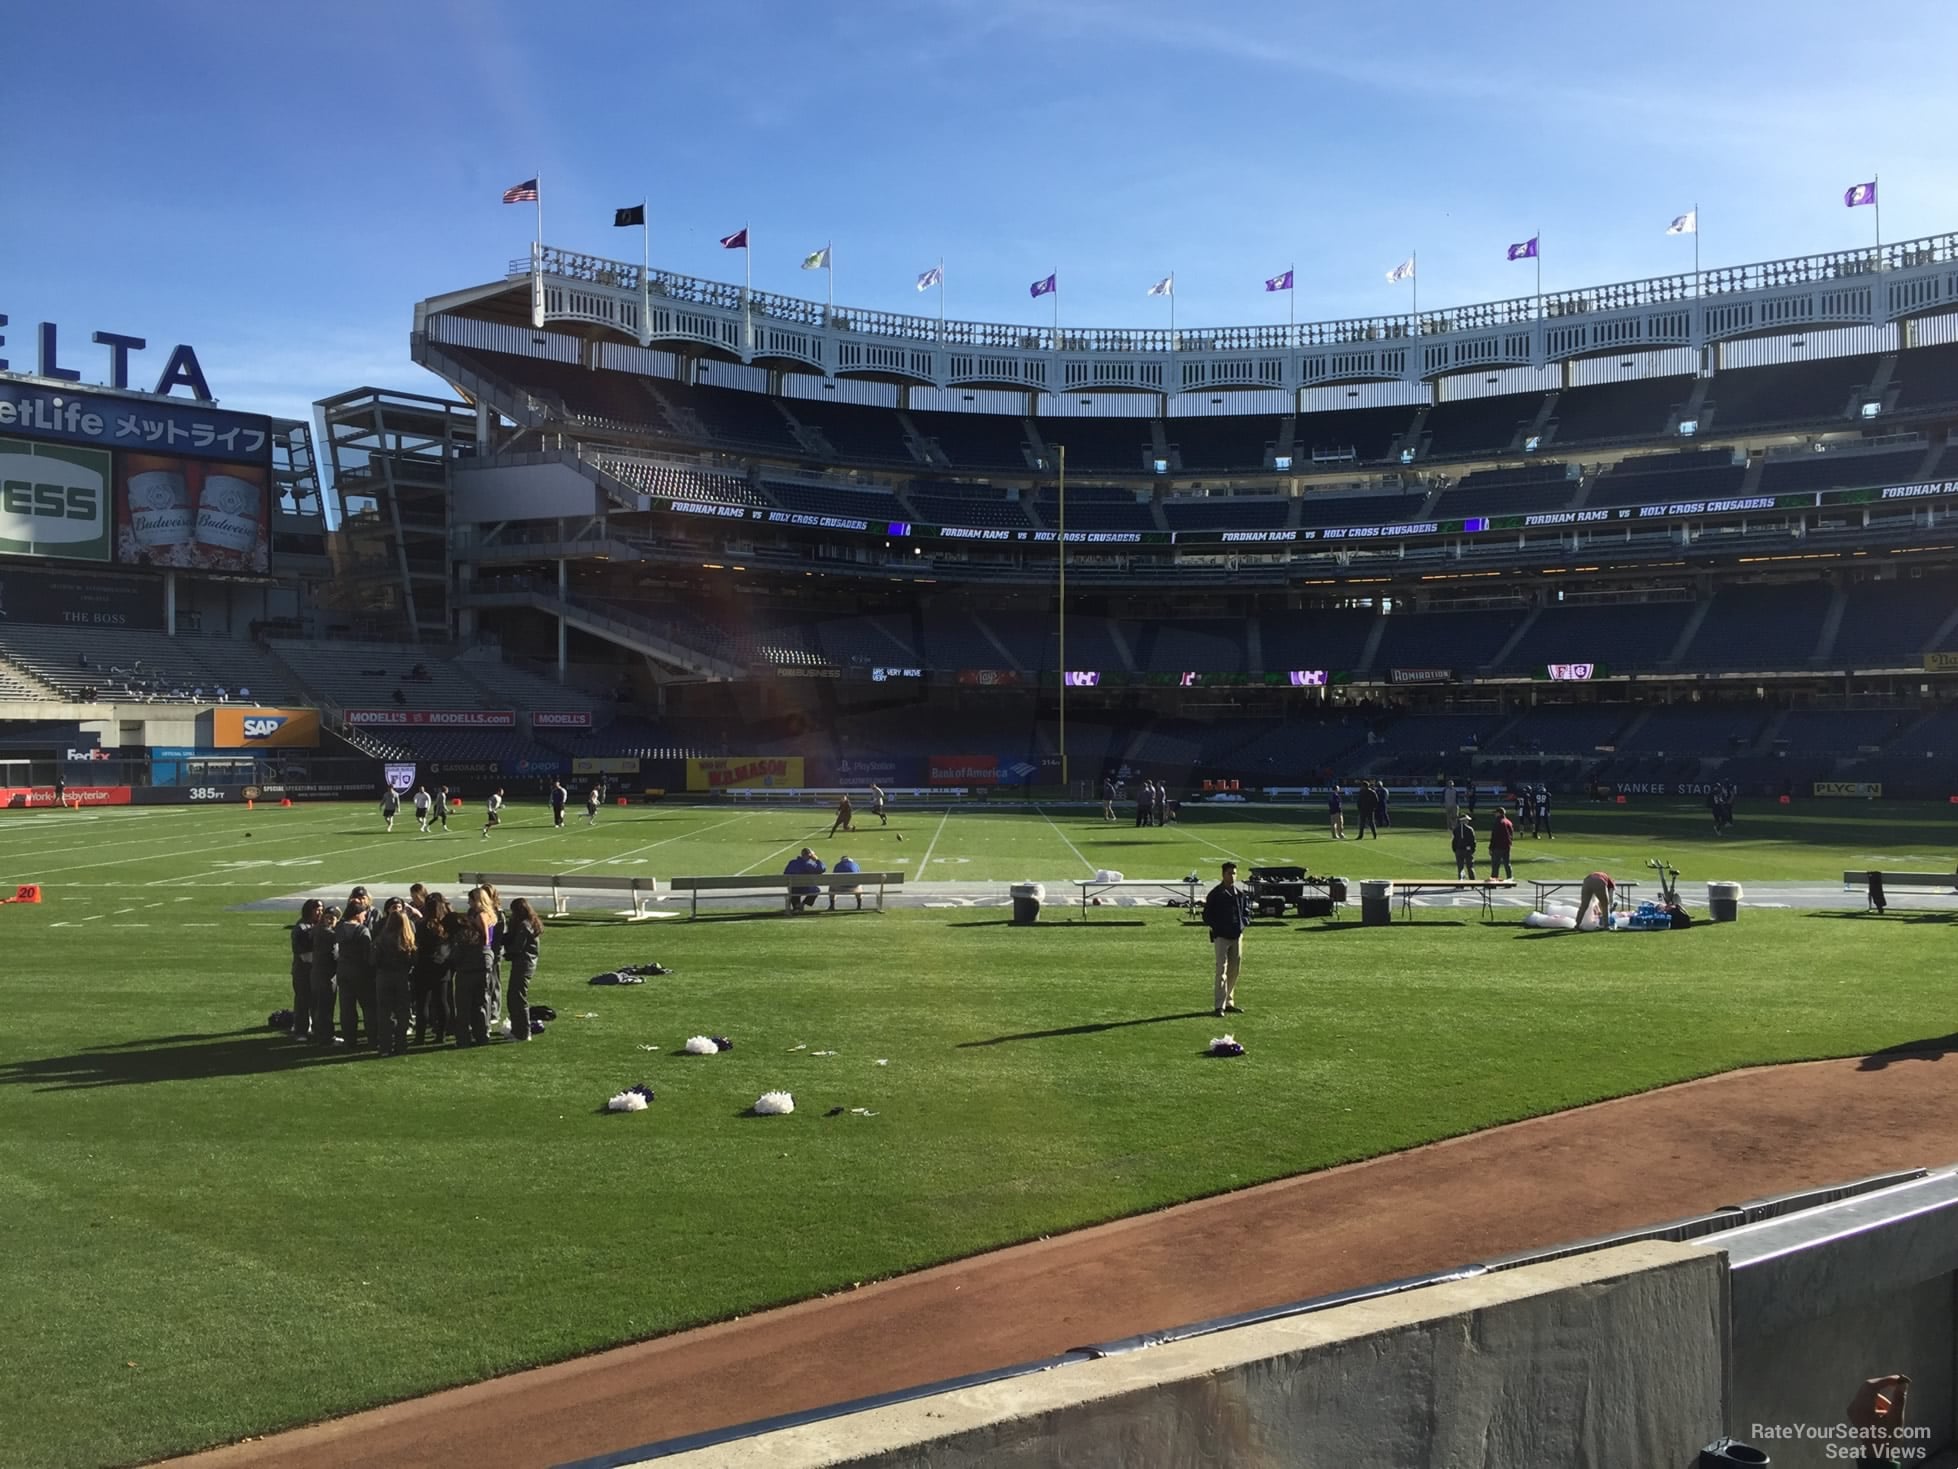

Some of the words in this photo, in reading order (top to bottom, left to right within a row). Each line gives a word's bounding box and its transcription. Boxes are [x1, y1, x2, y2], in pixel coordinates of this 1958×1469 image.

[0, 314, 213, 400] LTA
[115, 414, 266, 452] メットライフ
[1881, 484, 1942, 498] FORDHAM
[0, 480, 97, 521] ESS
[671, 501, 717, 515] FORDHAM
[717, 506, 744, 518] RAMS
[769, 511, 790, 522] HOLY
[791, 514, 818, 525] CROSS
[819, 517, 868, 530] CRUSADERS
[1525, 512, 1576, 525] FORDHAM
[1577, 510, 1608, 523] RAMS
[1640, 505, 1667, 518] HOLY
[1668, 502, 1705, 515] CROSS
[1706, 497, 1775, 513] CRUSADERS
[940, 527, 982, 538] FORDHAM
[982, 530, 1009, 540] RAMS
[1034, 531, 1057, 541] HOLY
[1058, 532, 1086, 542] ROSS
[1087, 532, 1141, 543] CRUSADERS
[1222, 531, 1267, 542] FORDHAM
[1268, 531, 1296, 541] RAMS
[1323, 528, 1347, 539] HOLY
[1348, 526, 1380, 537] CROSS
[1381, 523, 1438, 536] CRUSADERS
[63, 611, 89, 622] THE
[93, 612, 127, 624] BOSS
[1393, 669, 1450, 682] ADMIRATION
[350, 711, 407, 723] MODELL'S
[430, 712, 510, 724] MODELLS.com
[538, 712, 586, 724] MODELL'S
[244, 720, 279, 736] SAP
[67, 748, 110, 761] FedEx
[430, 763, 439, 773] G
[442, 764, 487, 772] GATORADE
[489, 763, 498, 773] G
[531, 761, 559, 772] pepsi
[932, 767, 955, 778] Bank
[956, 767, 966, 778] of
[967, 767, 1008, 778] America
[1616, 784, 1665, 794] YANKEE
[18, 887, 36, 898] 20
